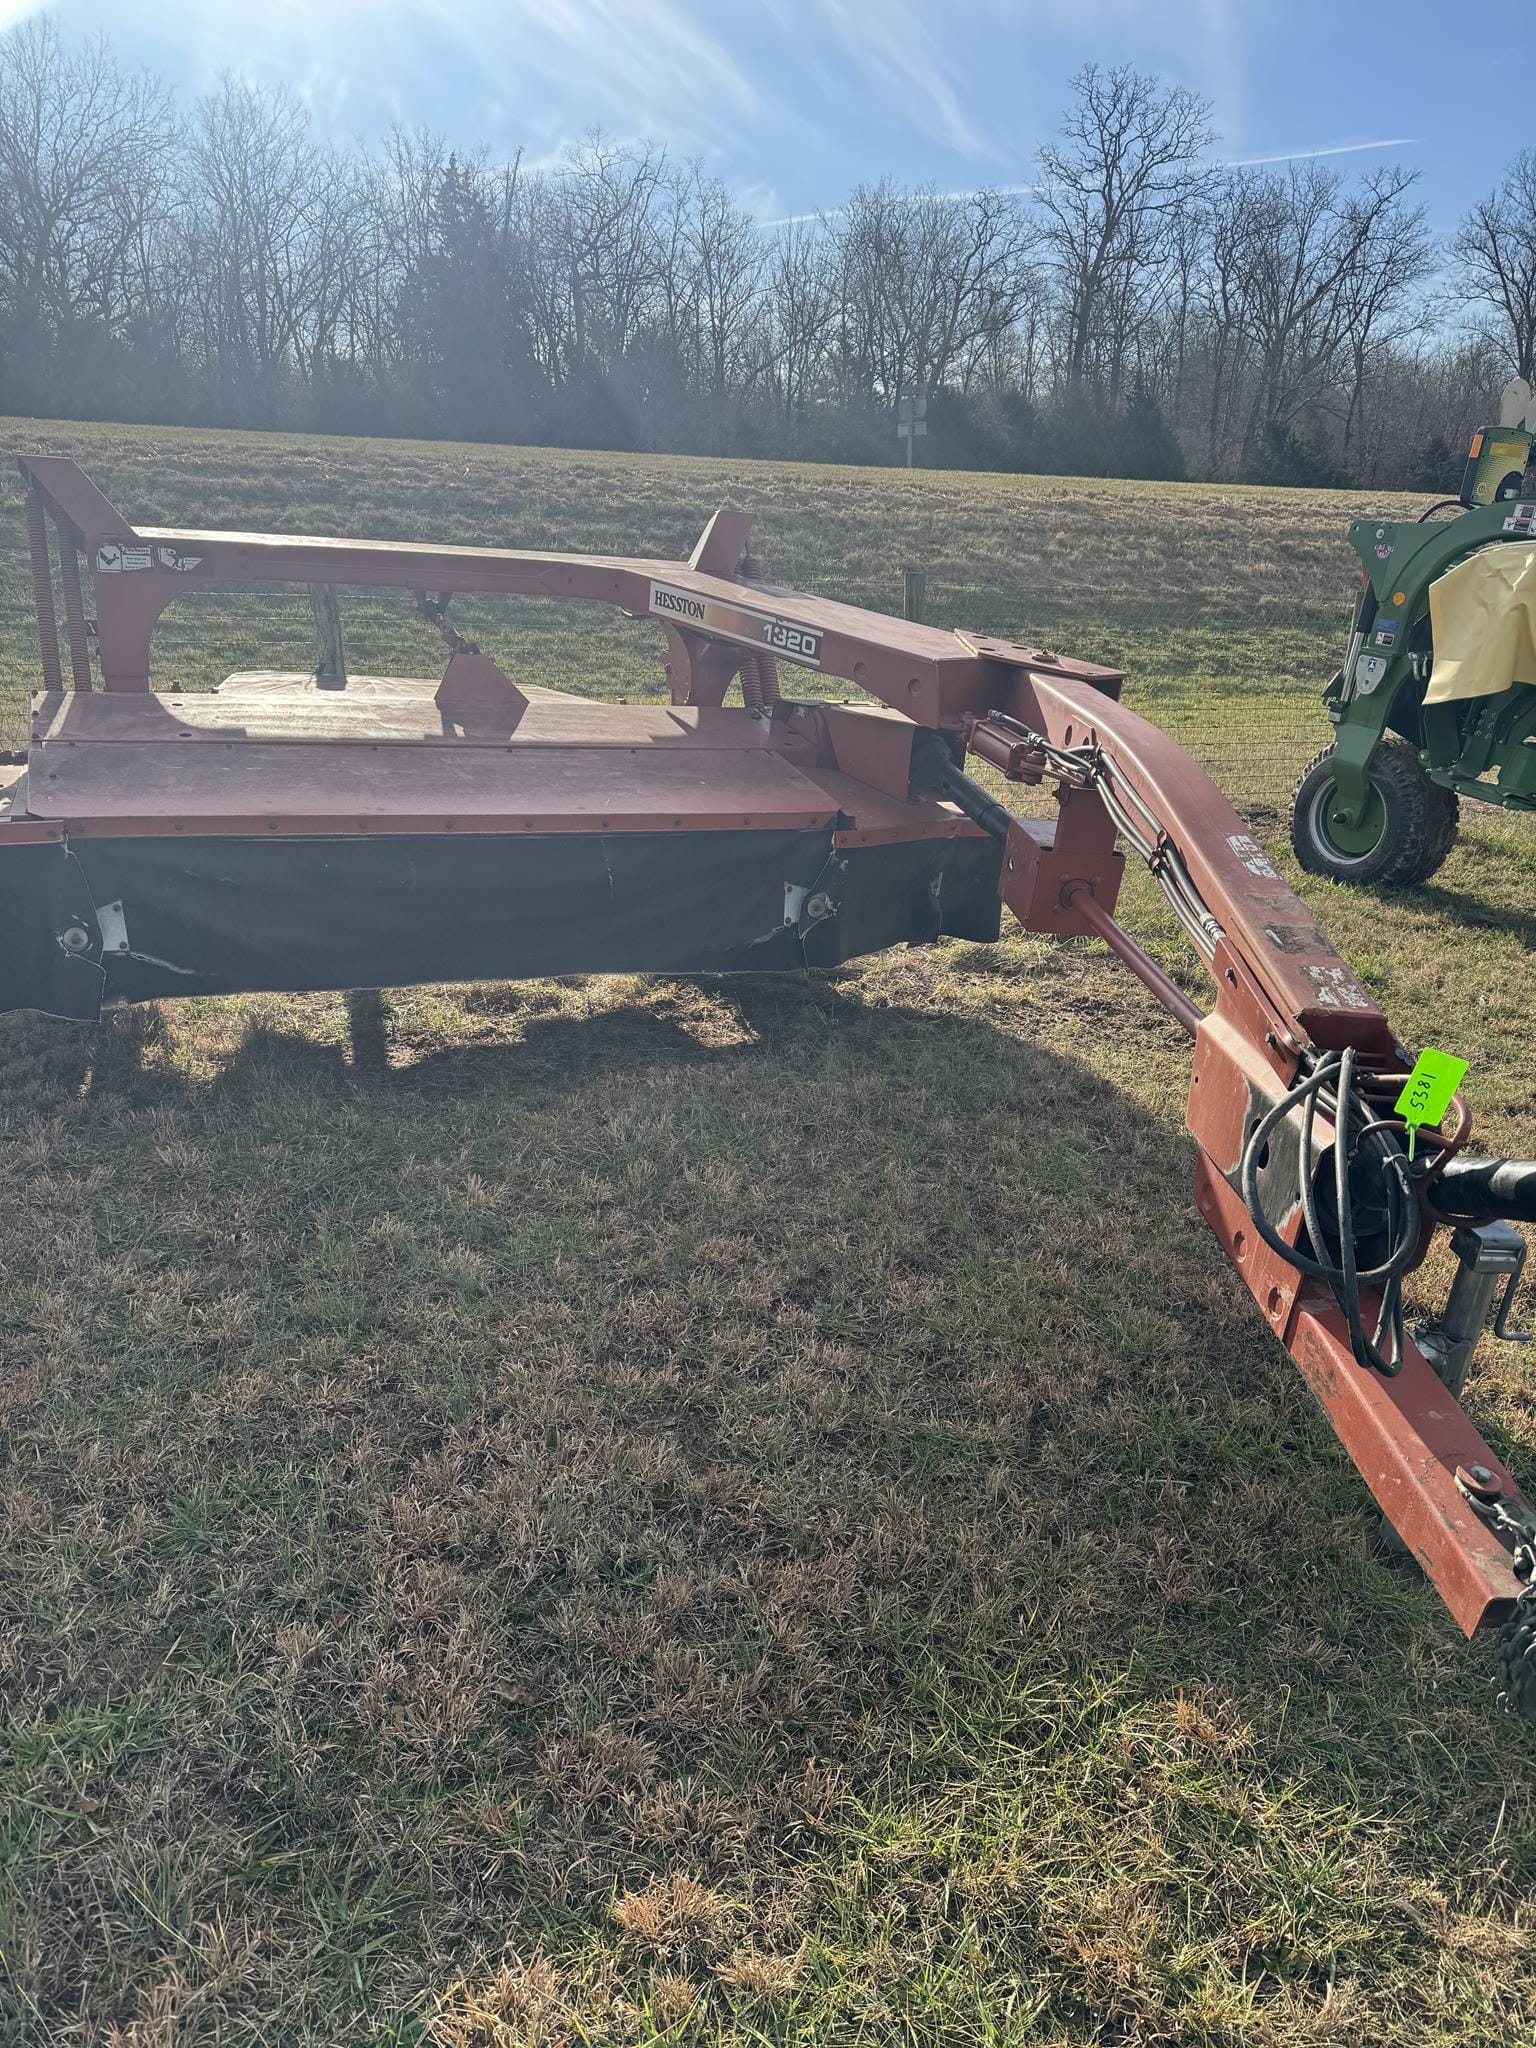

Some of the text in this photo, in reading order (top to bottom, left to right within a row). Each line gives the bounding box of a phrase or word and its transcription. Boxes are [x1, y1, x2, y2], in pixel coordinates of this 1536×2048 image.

[654, 590, 705, 620] HESSTON
[763, 623, 816, 655] 1320
[1410, 1073, 1437, 1111] 5381
